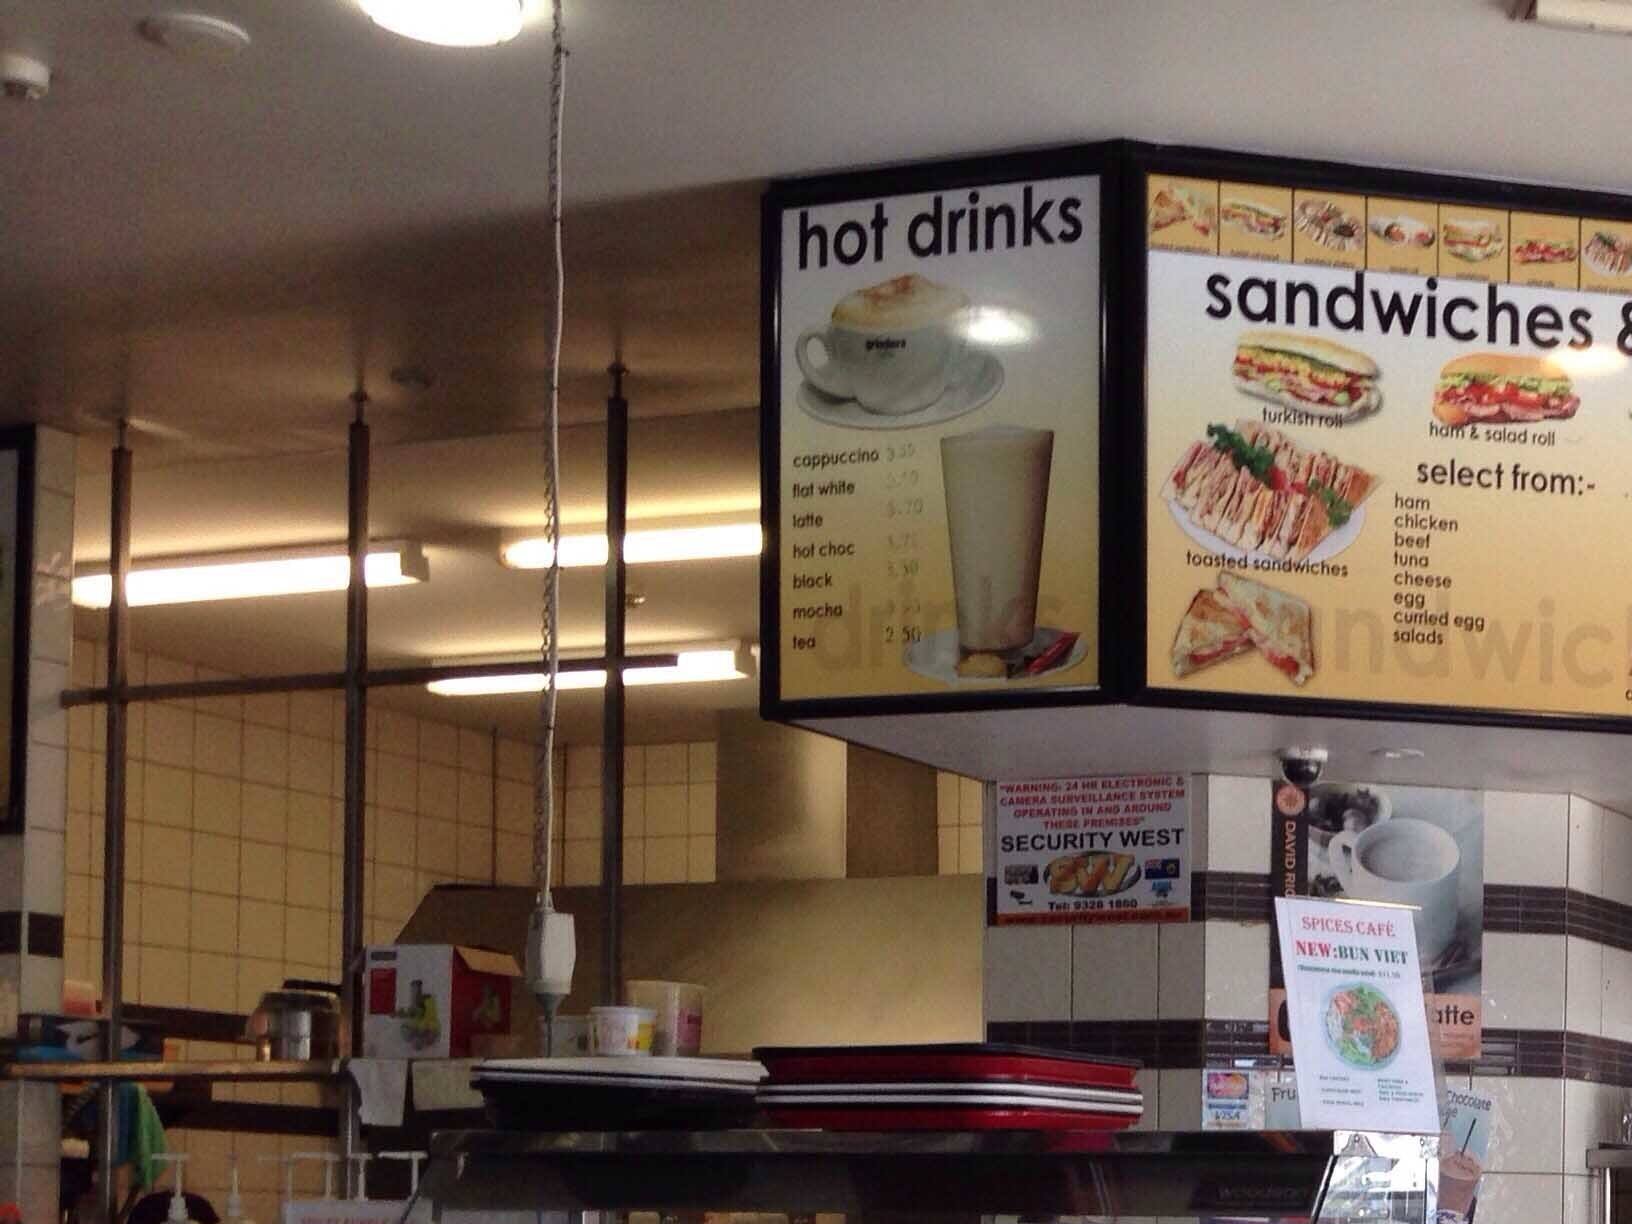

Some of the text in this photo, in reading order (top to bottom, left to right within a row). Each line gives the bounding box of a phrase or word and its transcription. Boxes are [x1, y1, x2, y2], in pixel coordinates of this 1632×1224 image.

[799, 185, 1084, 271] hot drinks
[1205, 270, 1595, 350] sandwiches
[1262, 407, 1345, 428] turkish roll
[1428, 422, 1556, 447] ham & salad roll
[792, 448, 880, 470] cappuccino
[1416, 458, 1504, 491] select
[792, 482, 856, 499] flat white
[1393, 491, 1431, 511] ham
[792, 513, 824, 529] latte
[1393, 513, 1459, 532] chicken
[1393, 531, 1431, 549] beef
[792, 541, 856, 559] hot choc
[1393, 551, 1430, 568] tuna
[1186, 550, 1349, 578] toasted sandwiches
[792, 573, 833, 590] black
[1393, 570, 1453, 589] cheese
[1393, 591, 1426, 610] egg
[792, 602, 843, 620] mocha
[1393, 610, 1486, 633] curried egg
[792, 635, 816, 650] tea
[1393, 627, 1444, 646] salads
[1065, 781, 1079, 792] 24
[1101, 776, 1174, 790] ELECTRONIC
[1000, 788, 1185, 807] CAMERA SURVEILLANCE SYSTEM
[1013, 801, 1172, 818] OPERATING IN AND AROUND
[1043, 819, 1080, 830] THESE
[1000, 827, 1185, 853] SECURITY WEST
[1284, 820, 1297, 870] DAVID
[1301, 916, 1354, 934] SPICES
[1374, 949, 1409, 965] VIET
[1271, 1087, 1297, 1103] Fru
